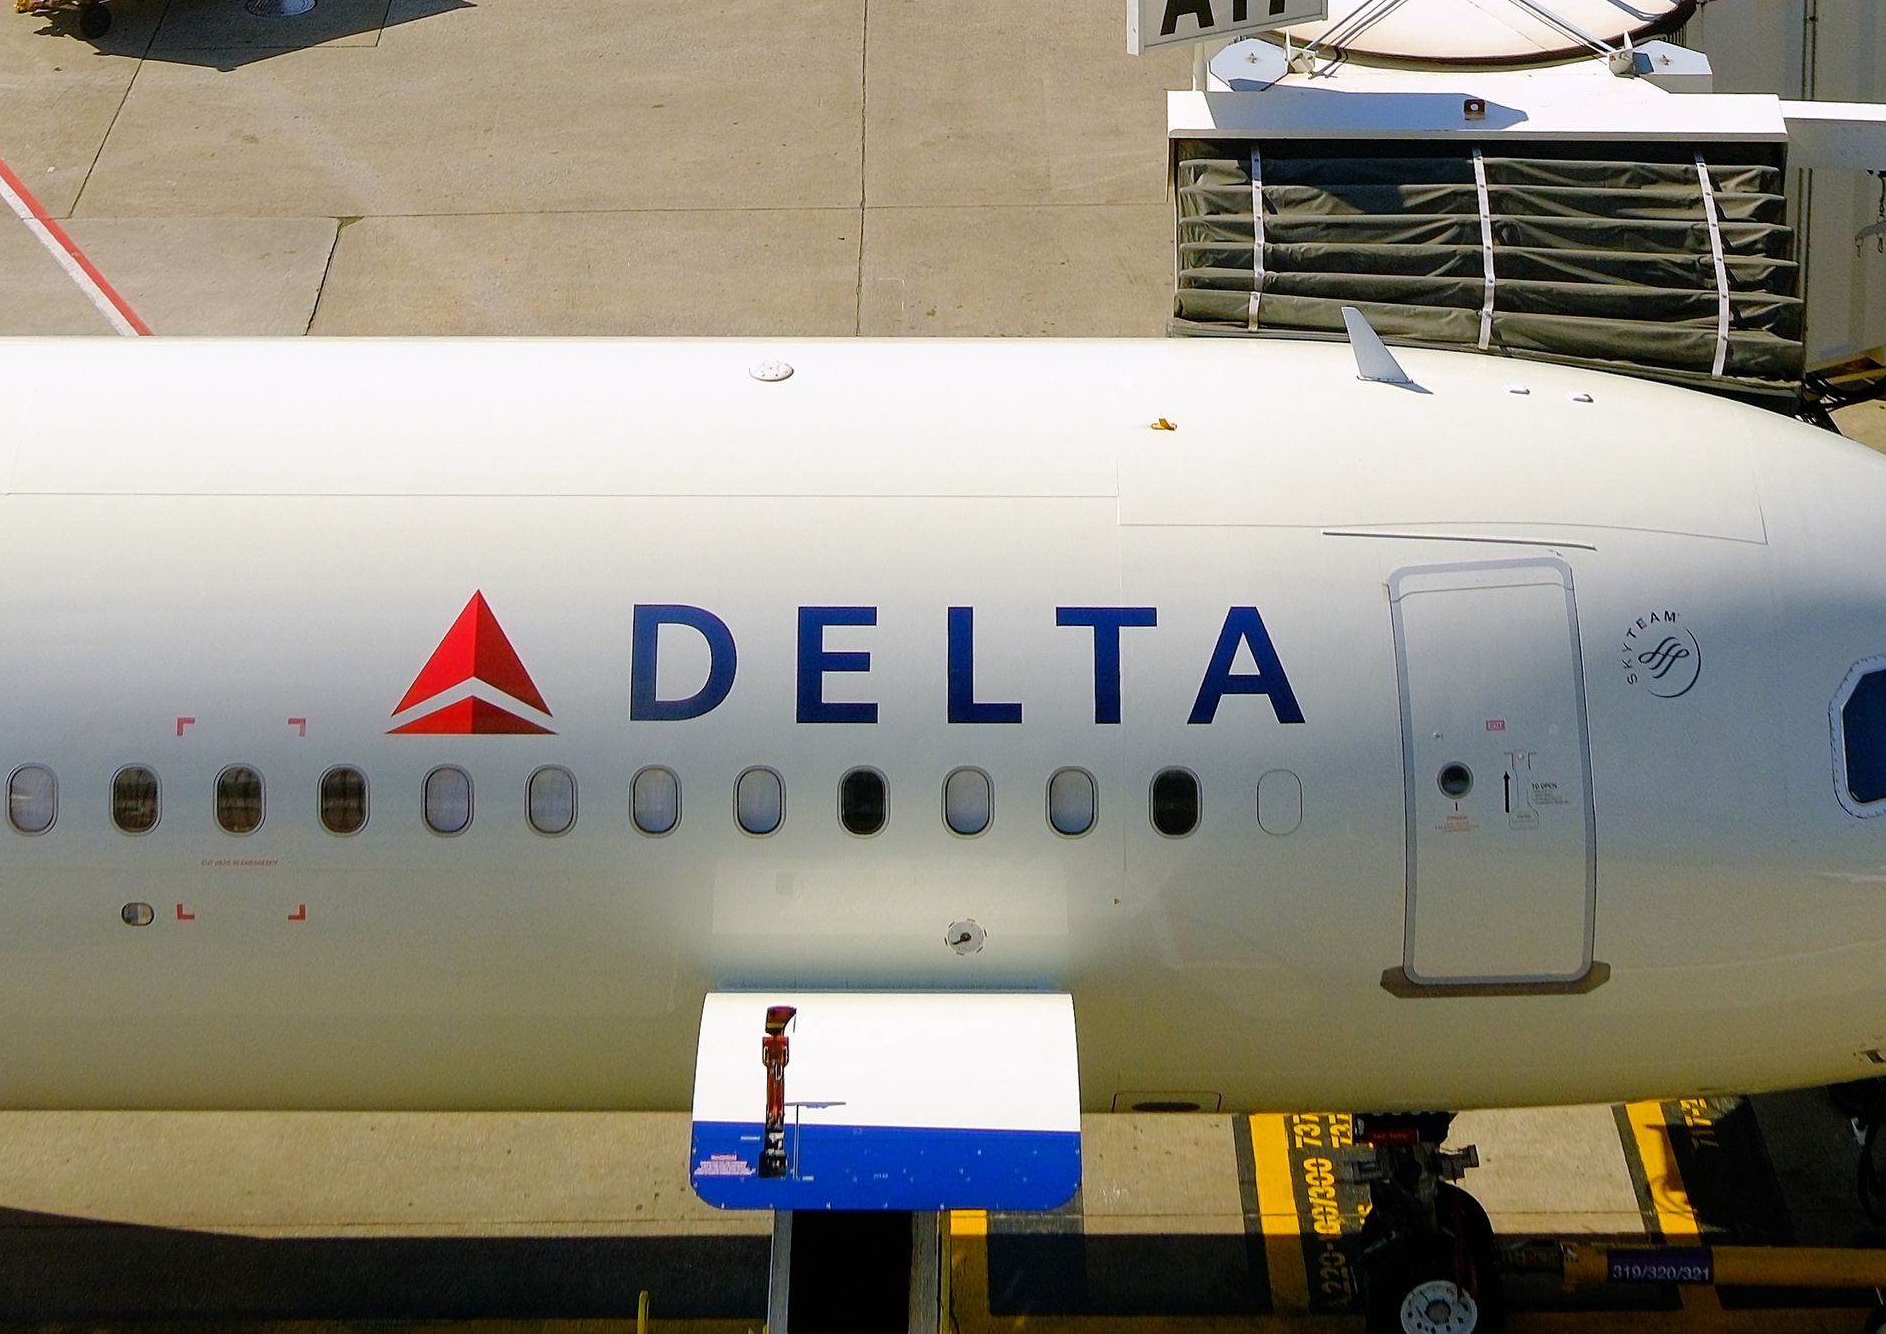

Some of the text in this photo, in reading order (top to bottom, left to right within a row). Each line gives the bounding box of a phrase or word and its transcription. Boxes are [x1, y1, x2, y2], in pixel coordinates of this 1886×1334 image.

[631, 604, 1306, 724] DELTA
[1621, 610, 1678, 685] SKYTEAM
[1613, 1264, 1710, 1282] 319/320/321
